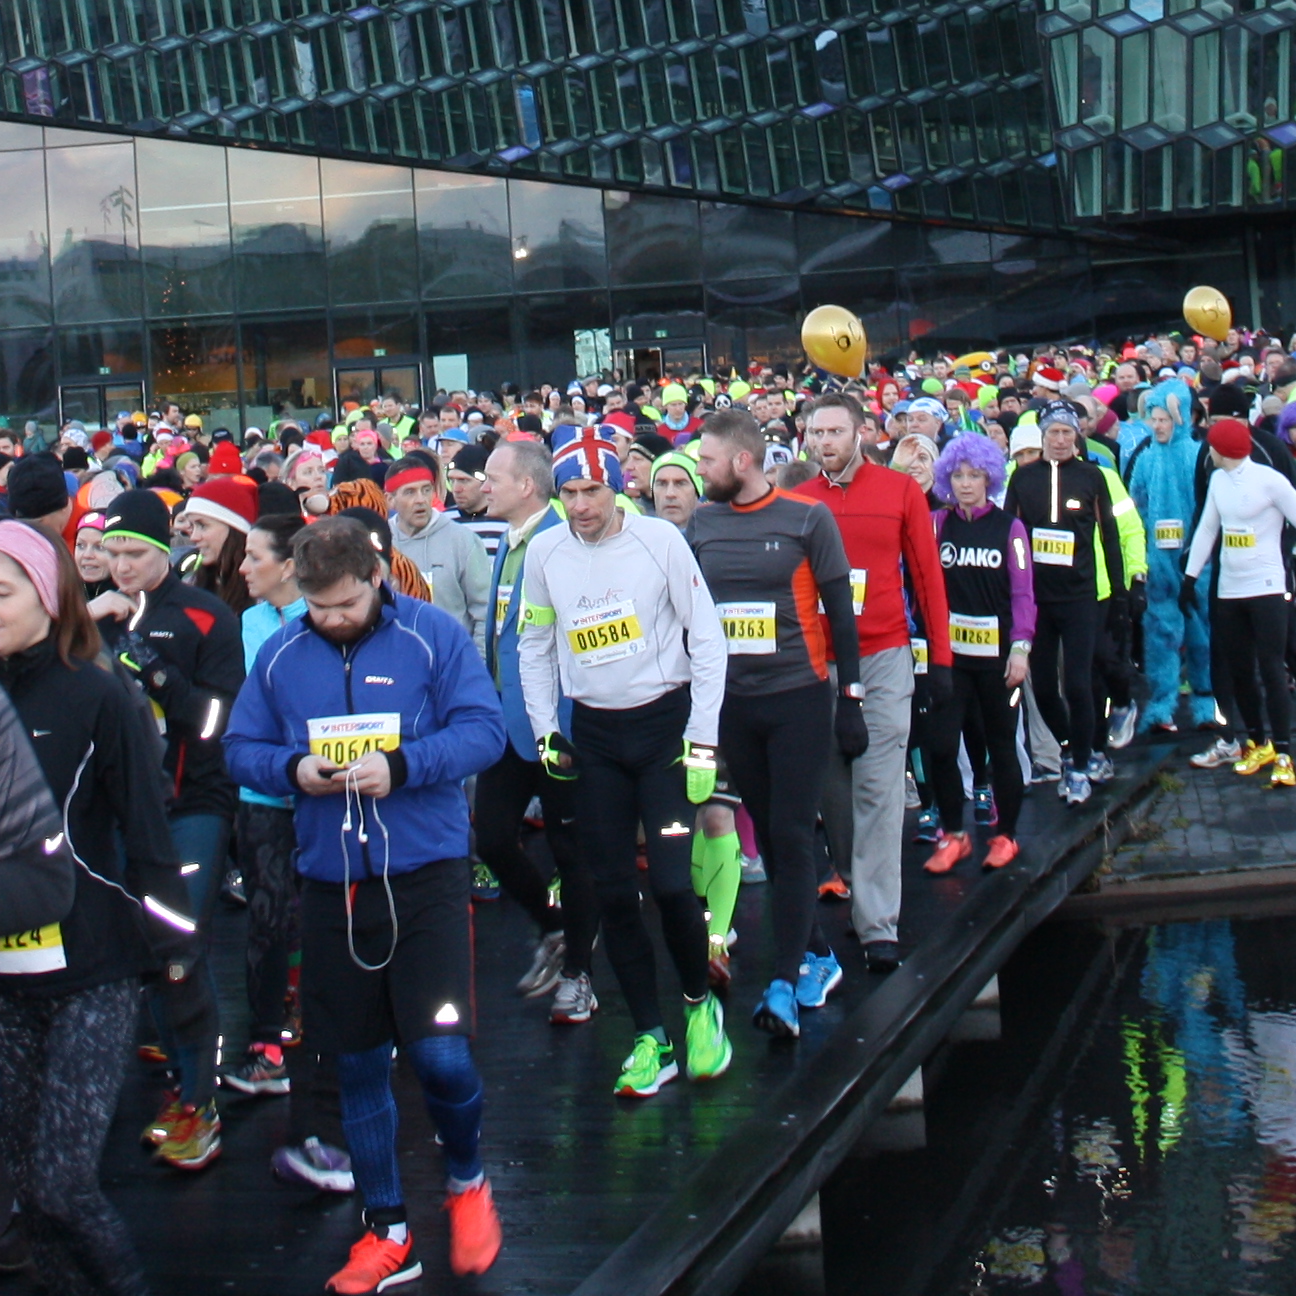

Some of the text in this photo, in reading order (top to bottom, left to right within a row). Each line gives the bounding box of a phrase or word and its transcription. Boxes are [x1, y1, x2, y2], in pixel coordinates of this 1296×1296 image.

[1037, 540, 1067, 554] 00151
[956, 547, 1002, 569] JAKO
[579, 607, 623, 625] INTERSPORT
[576, 620, 631, 651] 00584
[723, 619, 765, 638] 00363
[955, 627, 991, 644] 00262
[330, 721, 386, 733] INTERSPORT
